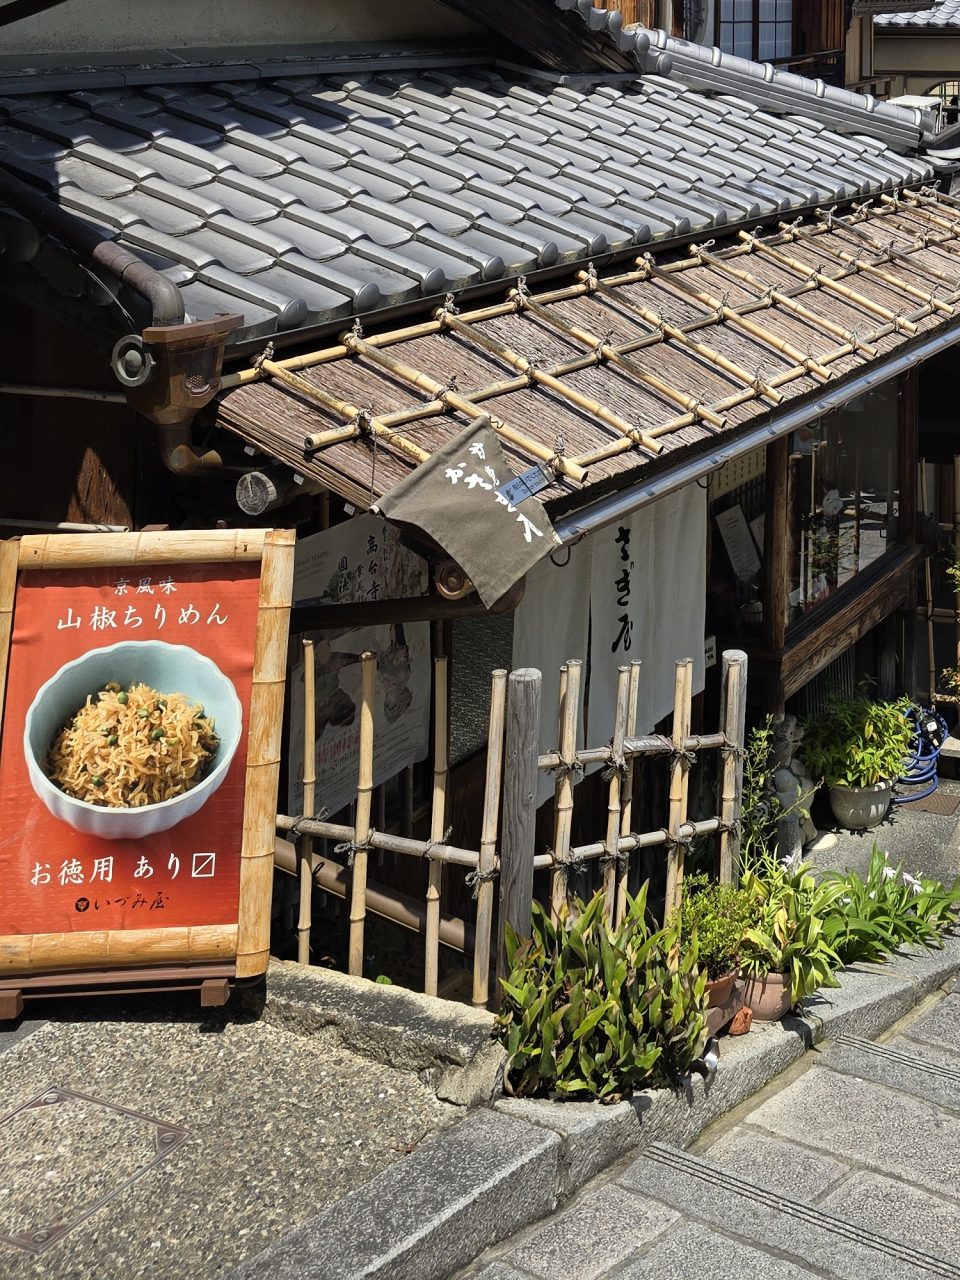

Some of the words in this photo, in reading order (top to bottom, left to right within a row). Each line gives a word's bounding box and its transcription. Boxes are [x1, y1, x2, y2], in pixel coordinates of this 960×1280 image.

[114, 576, 178, 596] 京風味
[57, 603, 228, 631] 山椒ちりめん
[94, 891, 171, 911] いづみ屋
